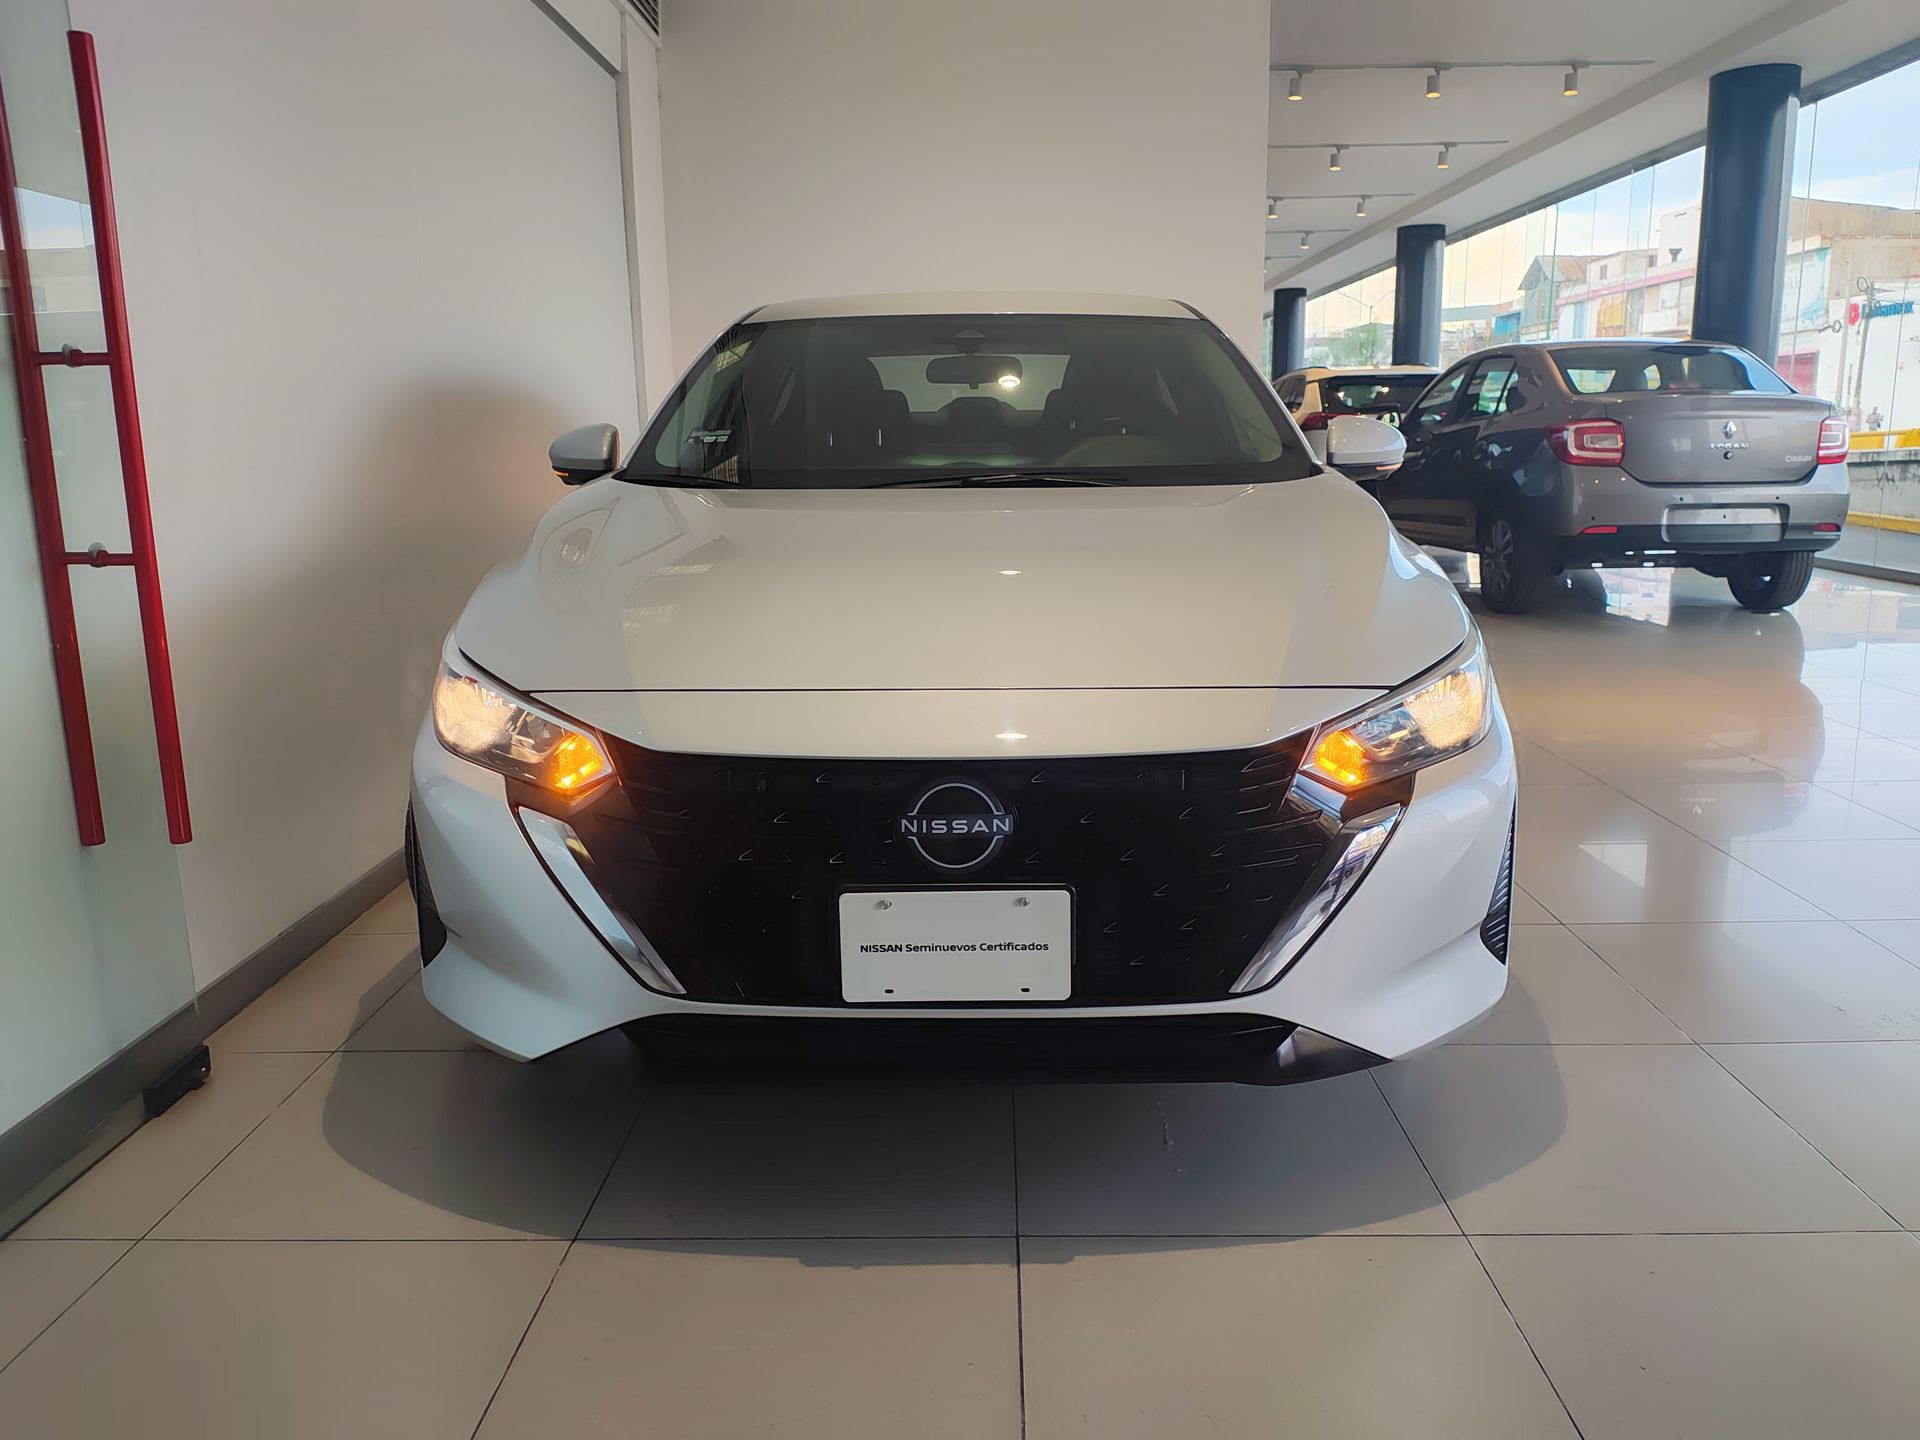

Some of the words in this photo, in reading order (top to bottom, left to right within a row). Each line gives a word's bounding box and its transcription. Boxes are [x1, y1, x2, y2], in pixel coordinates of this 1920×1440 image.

[901, 818, 1010, 834] NISSAN
[860, 943, 903, 953] NISSAN
[905, 942, 977, 953] Seminuevos
[979, 941, 1049, 952] Certificados
